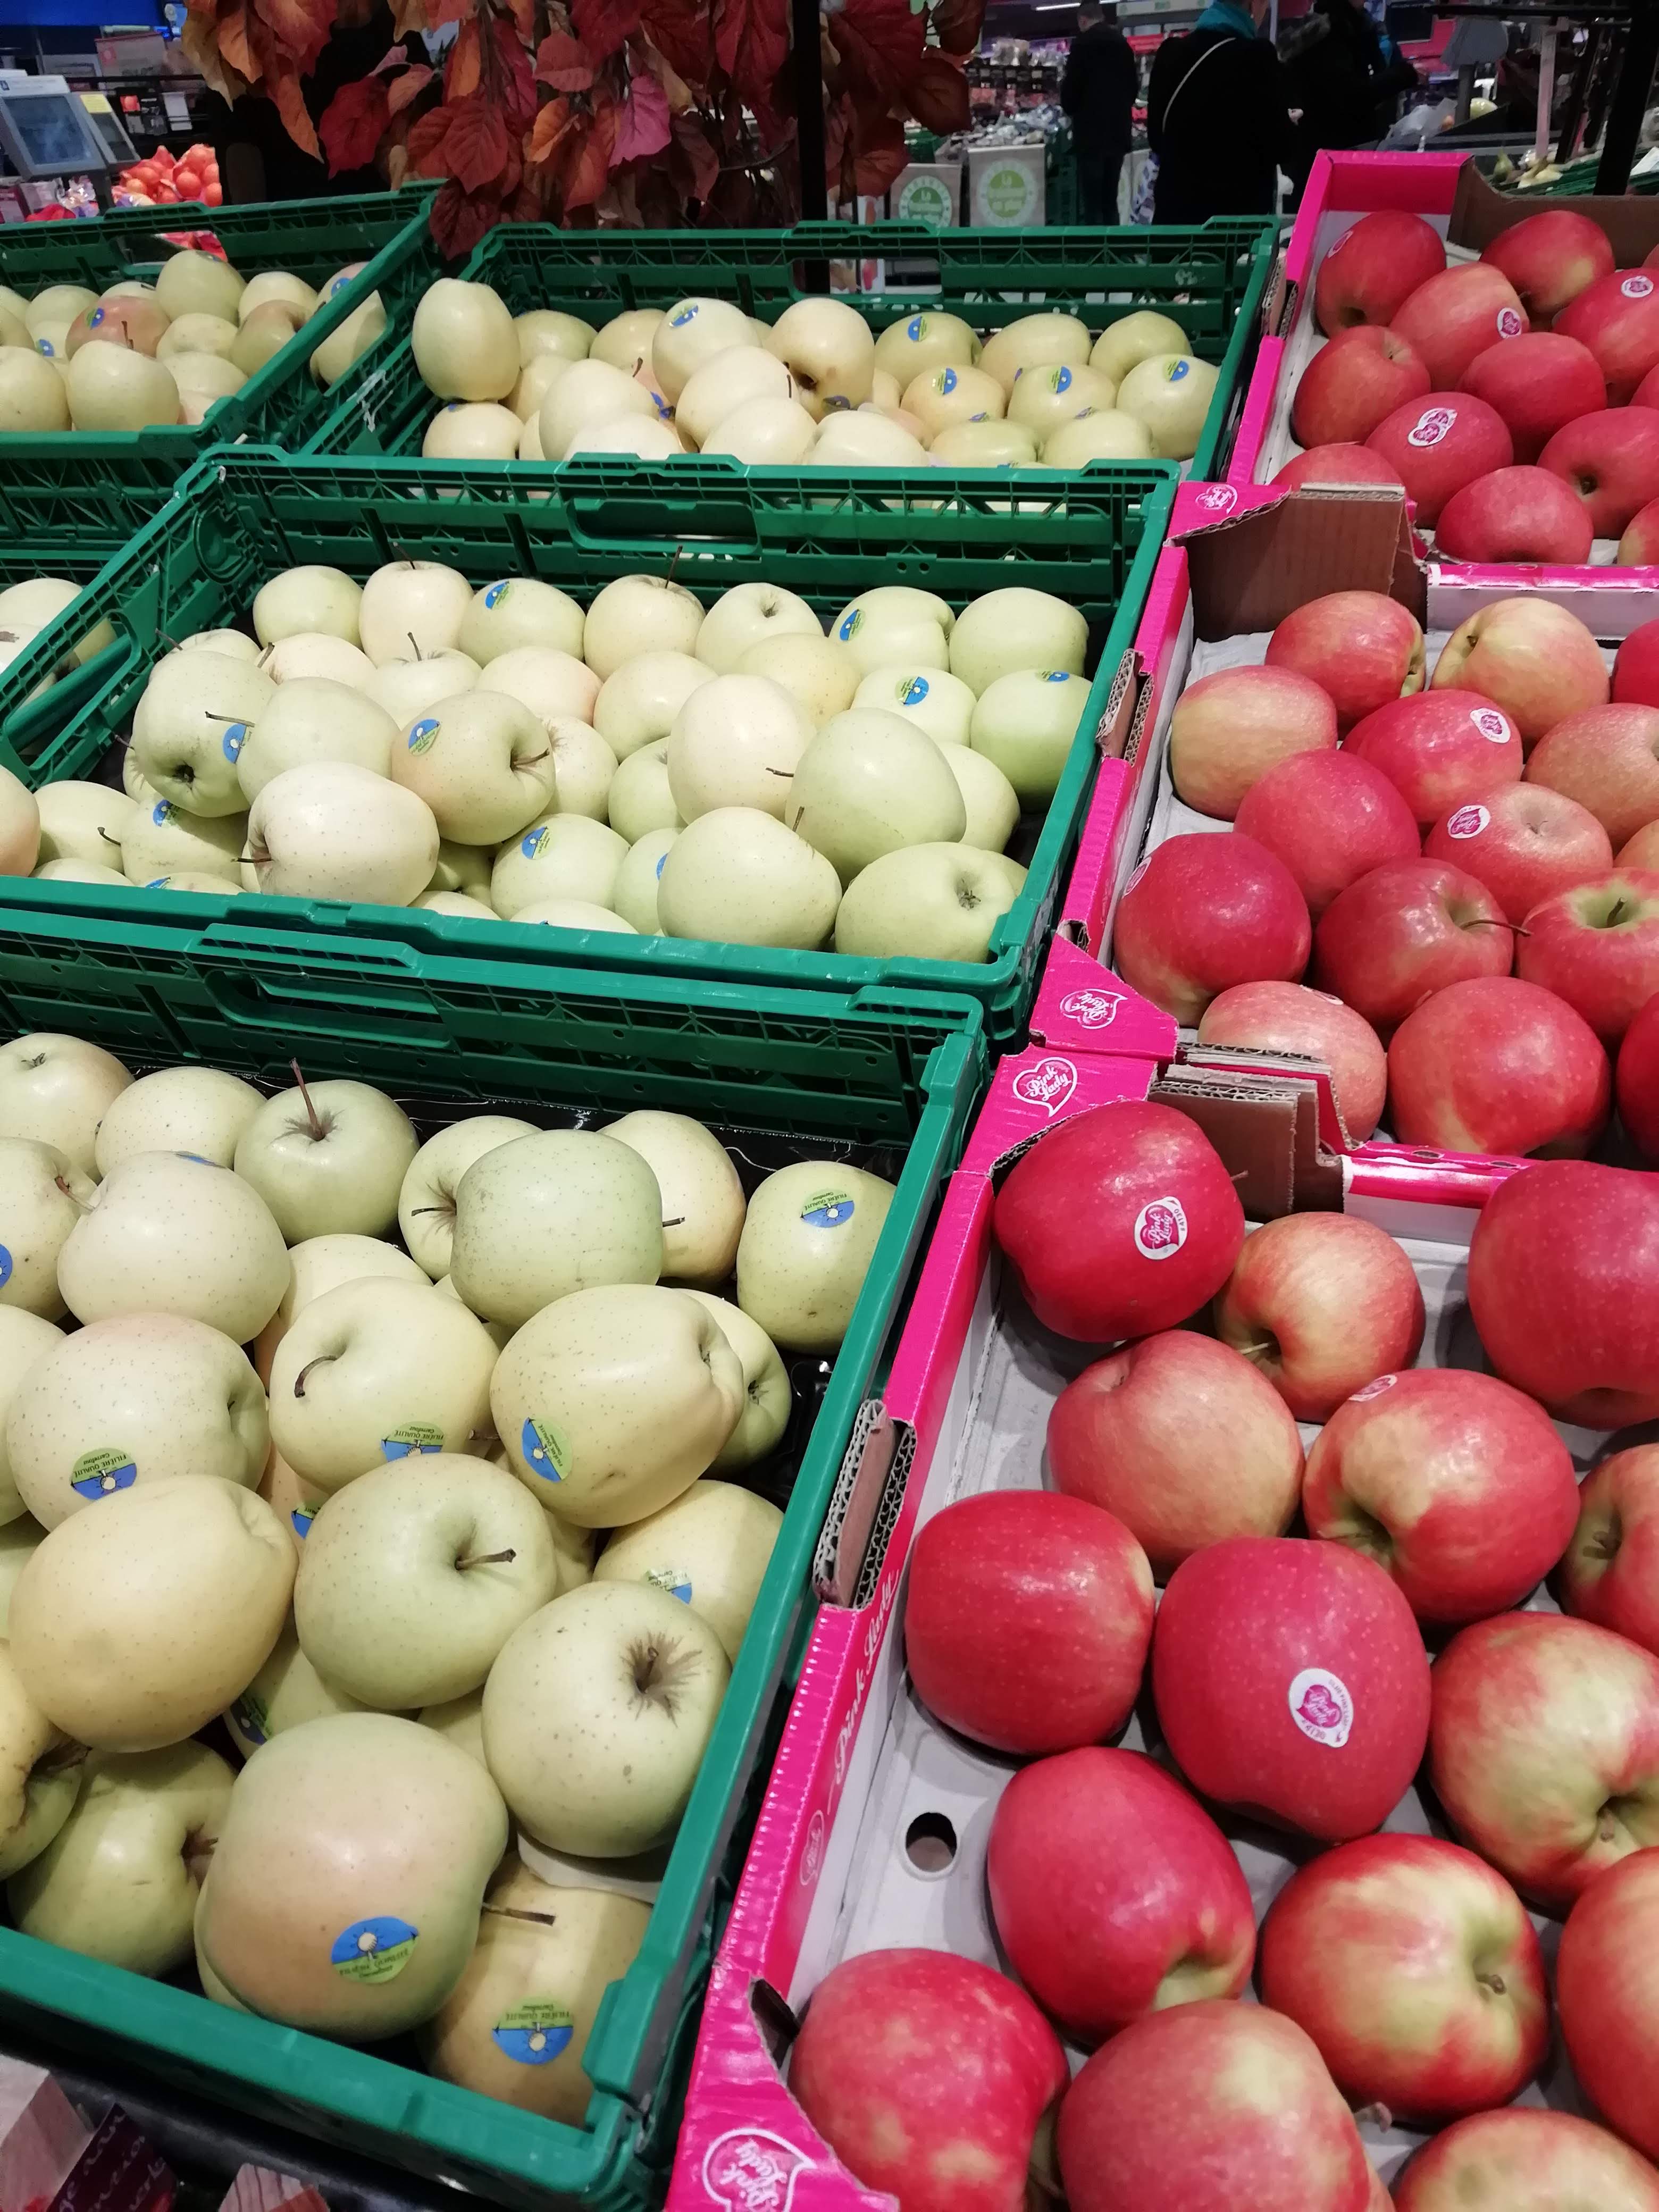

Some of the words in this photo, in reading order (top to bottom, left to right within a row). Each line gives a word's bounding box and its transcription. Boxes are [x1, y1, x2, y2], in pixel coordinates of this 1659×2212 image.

[1024, 1065, 1058, 1097] Pink
[1038, 1073, 1072, 1101] Lady
[1147, 1212, 1161, 1249] Pink
[83, 1452, 110, 1465] Carrefour
